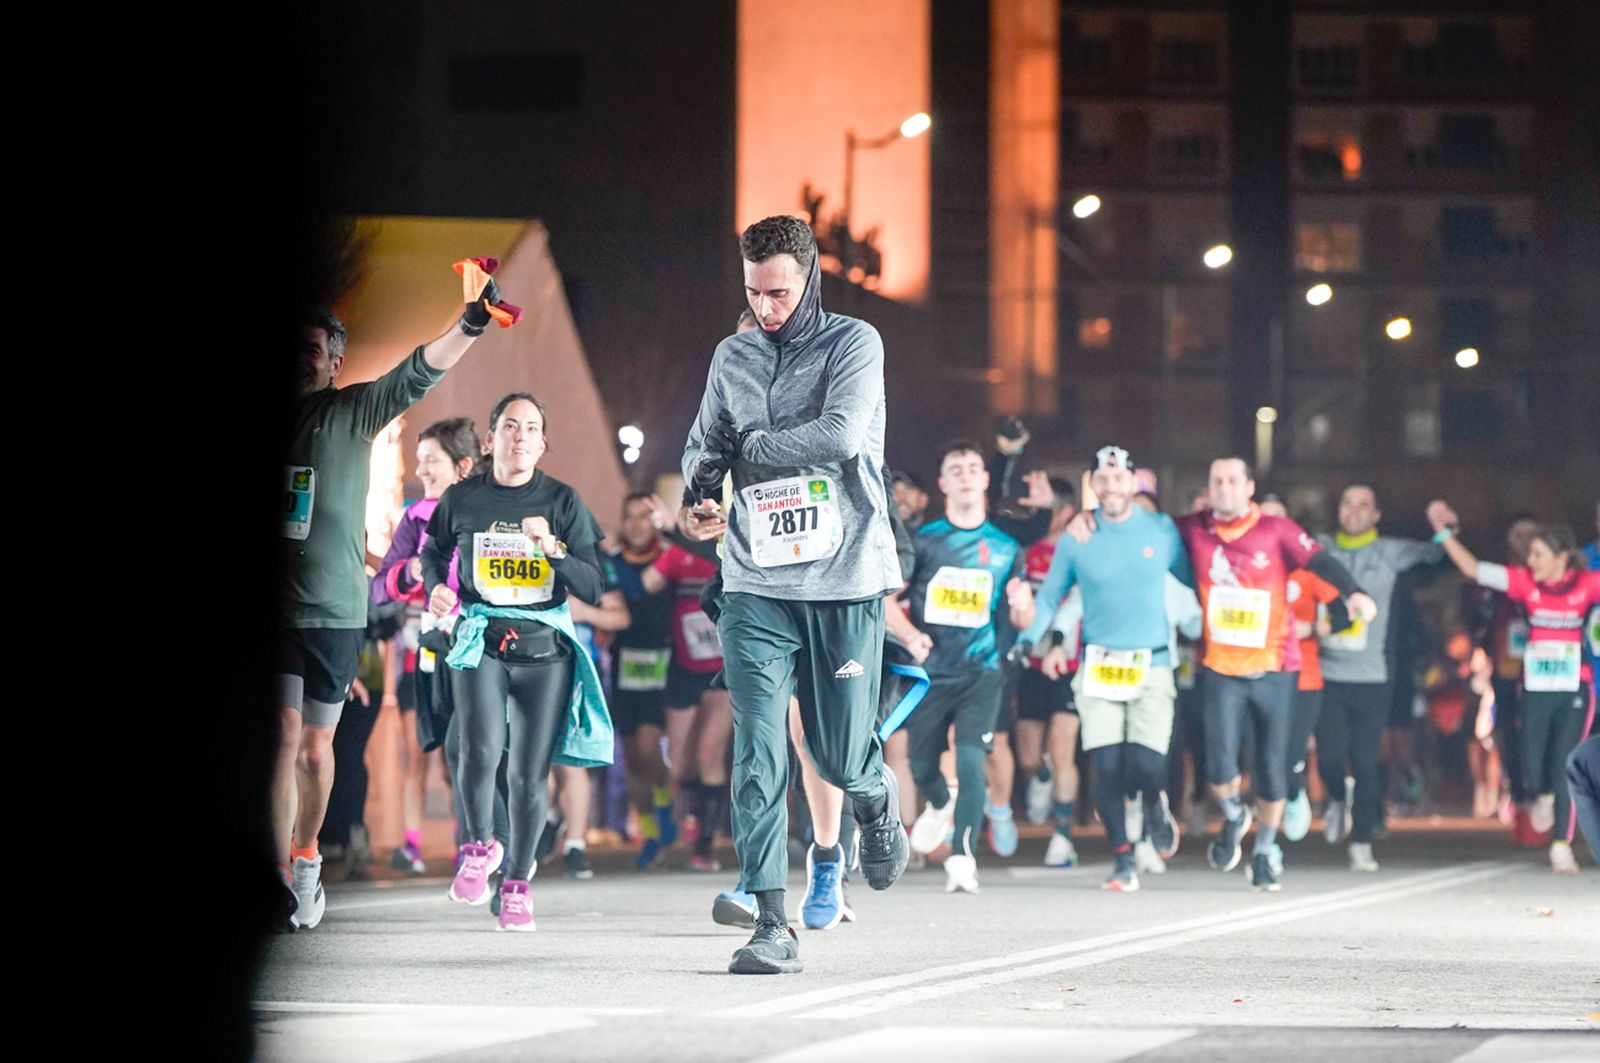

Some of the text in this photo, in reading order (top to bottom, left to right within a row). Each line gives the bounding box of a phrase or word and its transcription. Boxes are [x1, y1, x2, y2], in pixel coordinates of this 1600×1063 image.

[764, 487, 788, 499] NOCHE
[789, 486, 800, 496] DE
[757, 501, 773, 513] SAN
[768, 505, 818, 537] 2877
[493, 541, 515, 549] NOCHE
[483, 549, 498, 557] SAN
[489, 559, 540, 580] 5646
